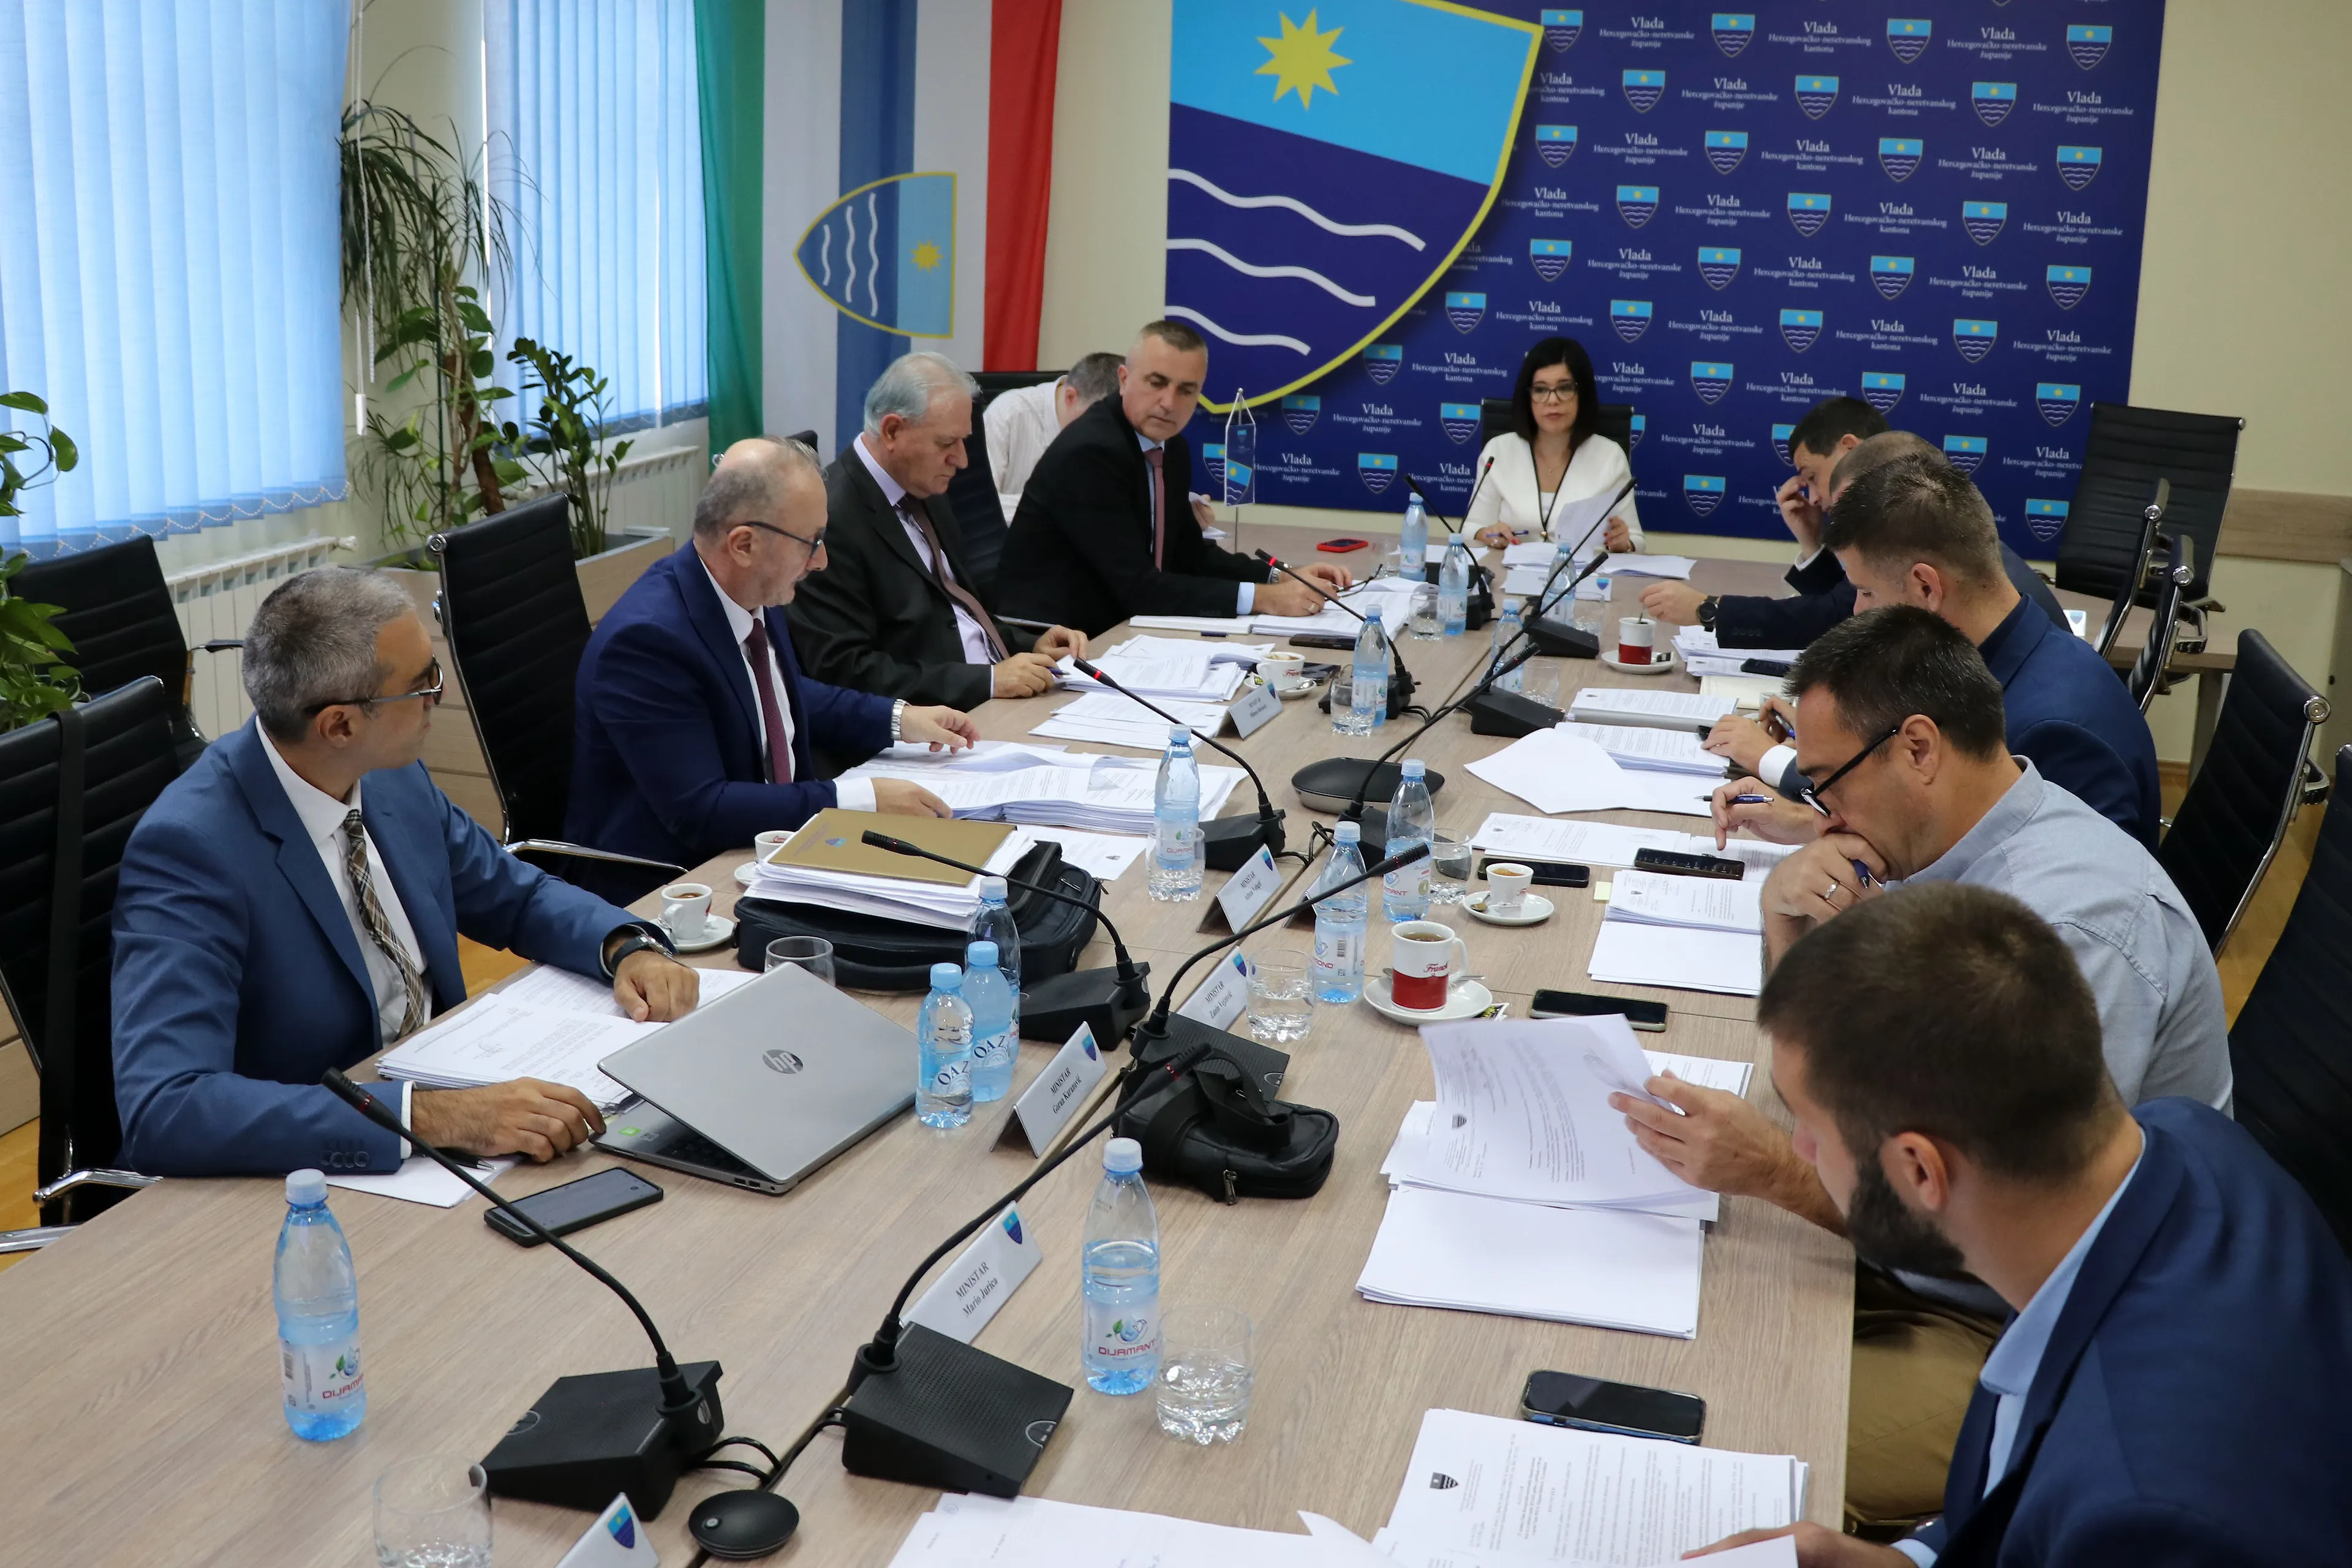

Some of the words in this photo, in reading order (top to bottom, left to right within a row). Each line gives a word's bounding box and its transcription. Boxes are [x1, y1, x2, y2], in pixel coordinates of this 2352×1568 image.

[1630, 16, 1665, 29] Vlada
[1803, 21, 1838, 35] Vlada
[1980, 26, 2016, 41] Vlada
[1630, 39, 1662, 49] županije
[1803, 43, 1834, 53] kantona
[1980, 50, 2013, 61] županije
[1539, 72, 1573, 85] Vlada
[1713, 77, 1747, 91] Vlada
[1887, 83, 1923, 97] Vlada
[2067, 91, 2102, 105] Vlada
[1713, 100, 1745, 111] županije
[1887, 106, 1919, 116] kantona
[2065, 114, 2099, 125] županije
[1624, 132, 1659, 146] Vlada
[1796, 139, 1831, 153] Vlada
[1624, 155, 1656, 165] županije
[1971, 146, 2007, 161] Vlada
[1796, 161, 1827, 172] kantona
[1970, 170, 2003, 181] županije
[1534, 186, 1567, 201] Vlada
[1706, 194, 1741, 208] Vlada
[1534, 208, 1564, 218] kantona
[1879, 202, 1914, 216] Vlada
[1706, 216, 1738, 227] županije
[2056, 211, 2092, 225] Vlada
[1879, 224, 1910, 235] kantona
[2056, 233, 2089, 244] županije
[1618, 247, 1652, 262] Vlada
[1788, 256, 1823, 270] Vlada
[1618, 270, 1649, 281] županije
[1962, 265, 1997, 280] Vlada
[1788, 277, 1819, 288] kantona
[1961, 288, 1994, 299] županije
[1528, 300, 1561, 314] Vlada
[1700, 309, 1733, 323] Vlada
[1529, 322, 1558, 331] kantona
[1871, 318, 1905, 333] Vlada
[1699, 331, 1730, 342] županije
[2046, 329, 2081, 344] Vlada
[1871, 341, 1901, 351] kantona
[1444, 352, 1477, 366] Vlada
[2045, 352, 2078, 363] županije
[1612, 361, 1645, 375] Vlada
[1444, 373, 1474, 383] kantona
[1780, 371, 1814, 386] Vlada
[1612, 383, 1642, 394] županije
[1952, 382, 1987, 396] Vlada
[1780, 393, 1811, 404] kantona
[1362, 403, 1394, 417] Vlada
[1951, 405, 1984, 415] županije
[1362, 424, 1392, 434] županije
[1692, 423, 1726, 437] Vlada
[1692, 445, 1722, 455] županije
[2036, 446, 2070, 460] Vlada
[1281, 453, 1312, 466] Vlada
[1439, 463, 1471, 475] Vlada
[2035, 469, 2066, 478] županije
[1283, 474, 1310, 483] županije
[1440, 483, 1468, 492] kantona
[1205, 980, 1226, 1004] MINISTAR
[763, 1050, 800, 1074] hp
[1050, 1066, 1071, 1096] MINISTAR
[1052, 1097, 1065, 1114] Goran
[1062, 1074, 1082, 1101] Karanović
[955, 1261, 990, 1302] MINISTAR
[962, 1295, 982, 1318] Mario
[979, 1277, 999, 1300] Jurica
